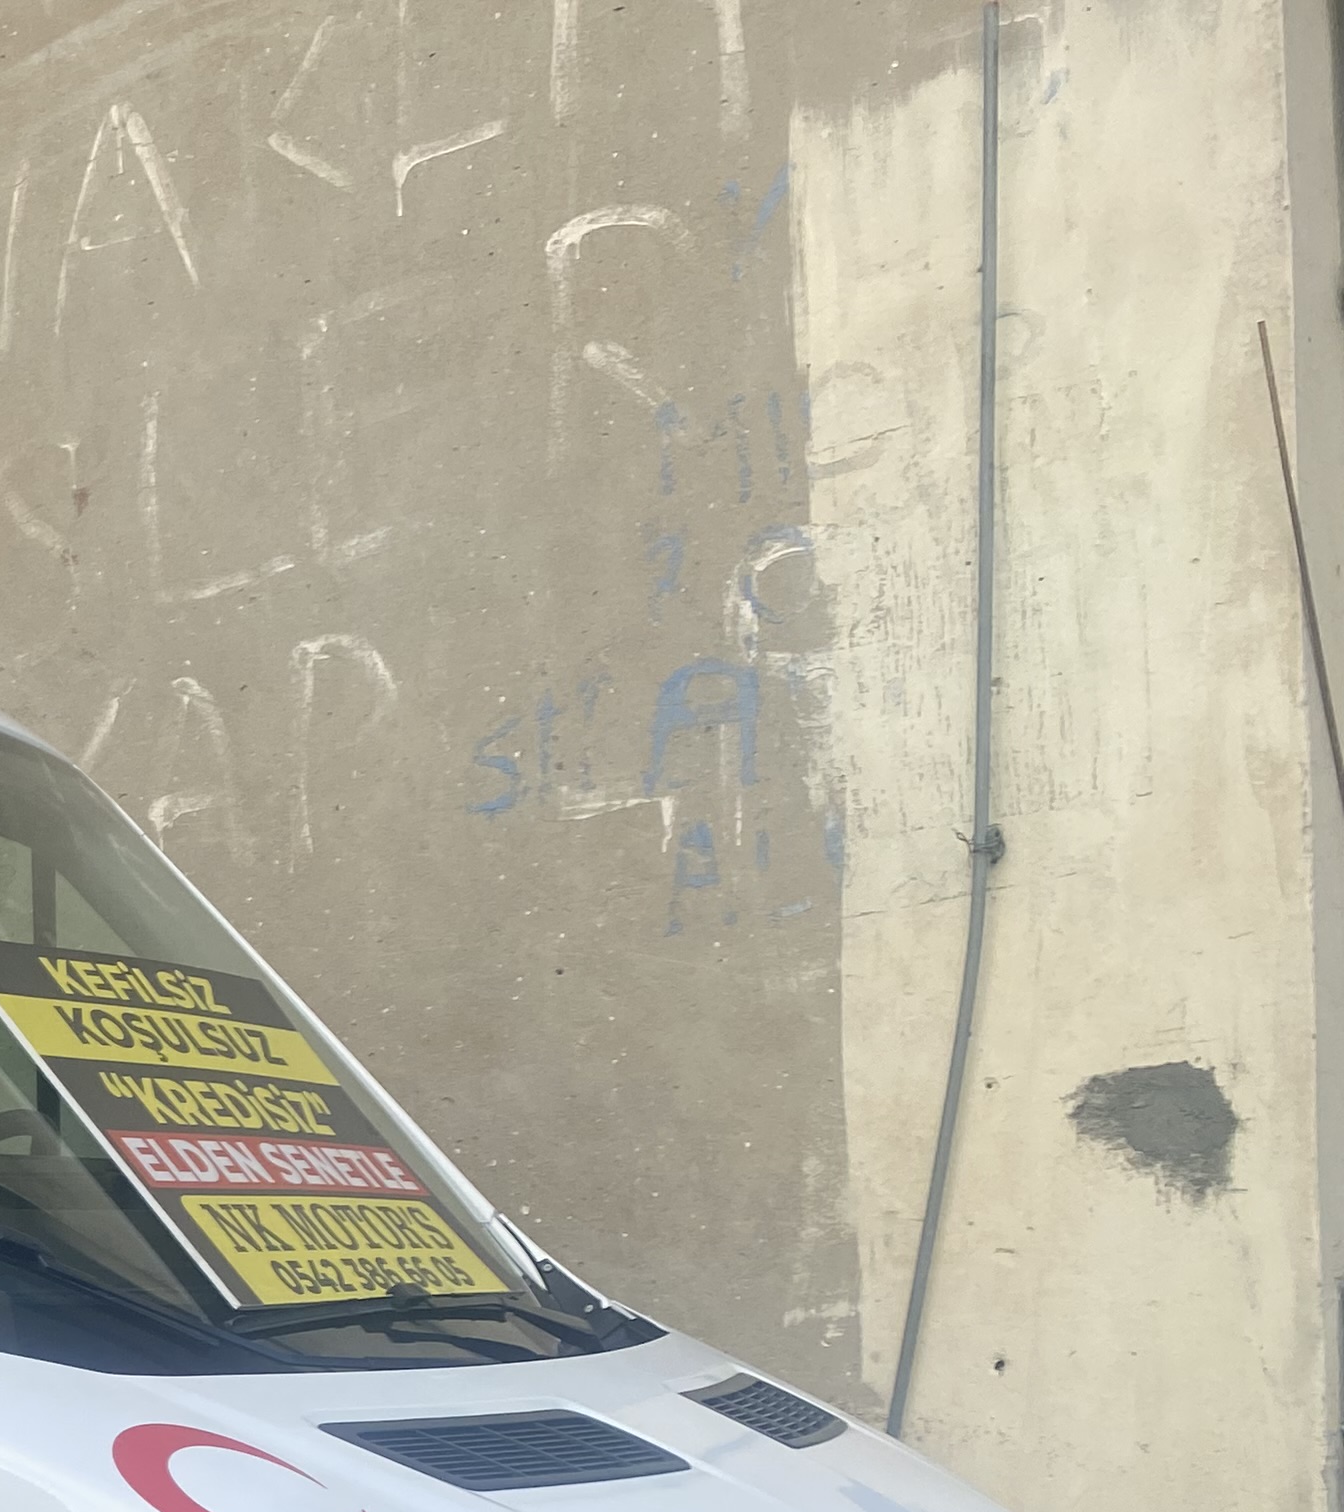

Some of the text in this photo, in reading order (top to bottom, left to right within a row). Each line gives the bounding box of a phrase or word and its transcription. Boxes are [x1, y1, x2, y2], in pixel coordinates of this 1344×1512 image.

[53, 1005, 289, 1066] KOŞULSUZ
[120, 1137, 420, 1192] ELDEN SENETLE
[199, 1203, 294, 1253] NK
[270, 1255, 476, 1295] 0542 386 66 05
